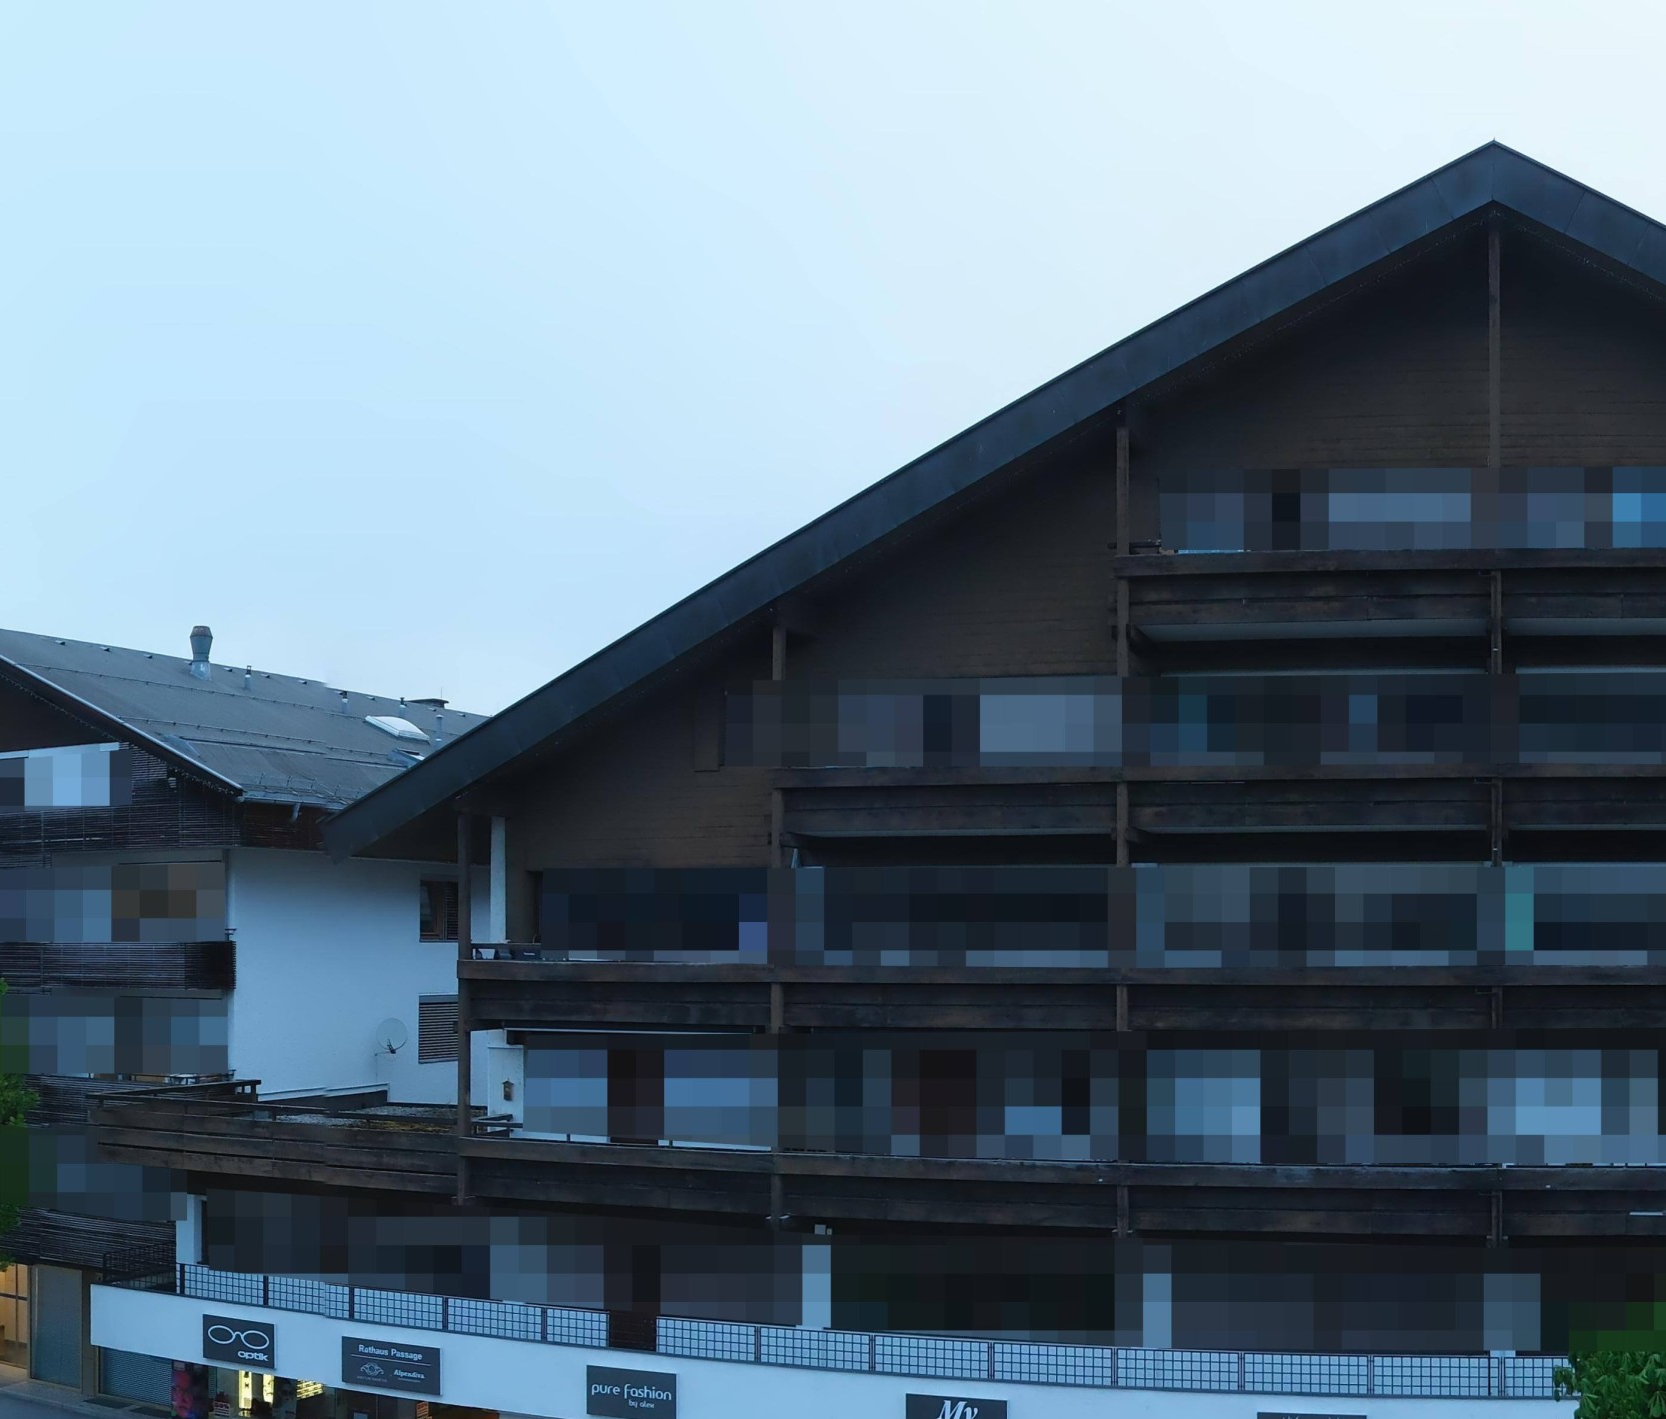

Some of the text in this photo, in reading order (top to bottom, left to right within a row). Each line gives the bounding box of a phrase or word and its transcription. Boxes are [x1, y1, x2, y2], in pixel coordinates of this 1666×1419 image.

[237, 1350, 268, 1362] optik
[391, 1348, 422, 1361] Passage
[591, 1383, 672, 1401] pure fashion
[628, 1399, 638, 1409] by
